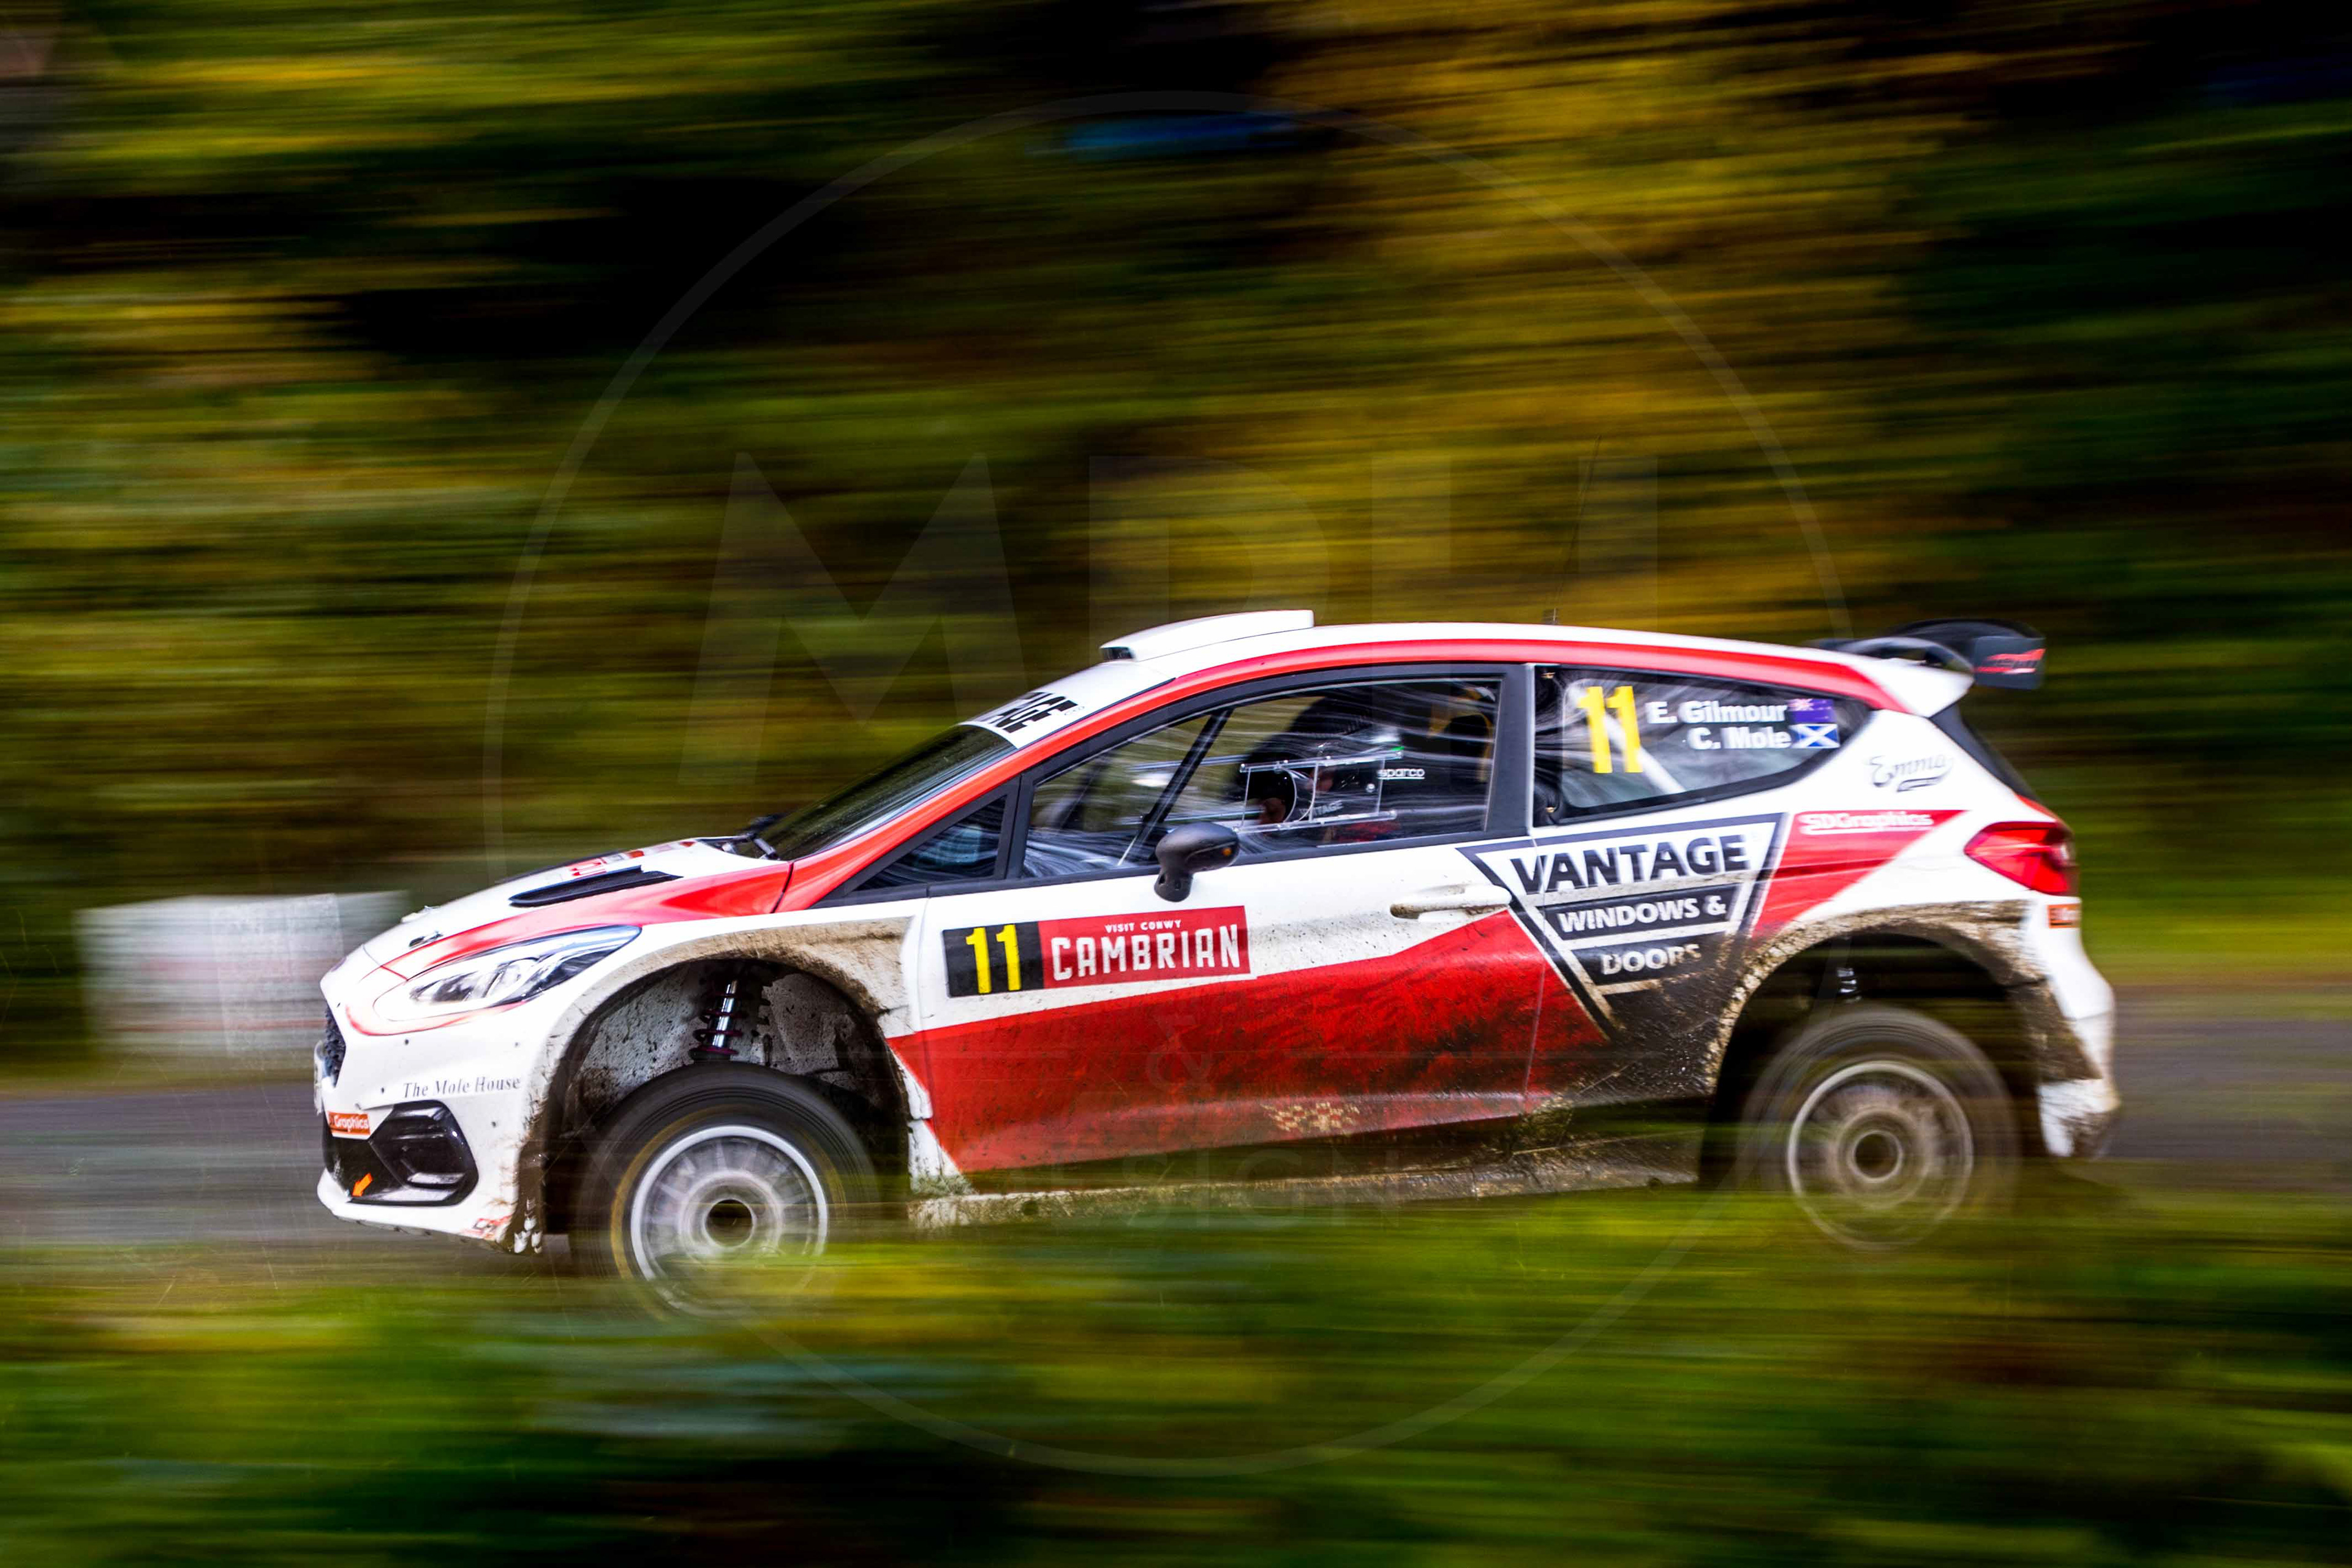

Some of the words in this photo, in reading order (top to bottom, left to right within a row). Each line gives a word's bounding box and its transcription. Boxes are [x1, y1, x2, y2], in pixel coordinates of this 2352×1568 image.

[1645, 701, 1678, 723] E.
[1678, 700, 1788, 723] Gilmour
[1577, 685, 1643, 774] 11
[1687, 727, 1721, 750] C.
[1721, 726, 1792, 749] Mole
[1377, 769, 1425, 777] sparco
[1510, 834, 1750, 895] VANTAGE
[1104, 923, 1135, 933] VISIT
[1140, 919, 1182, 930] CONWY
[1556, 898, 1700, 932] WINDOWS
[1703, 895, 1727, 915] &
[966, 924, 1020, 993] 11
[1051, 924, 1240, 981] CAMBRIAN
[404, 1082, 429, 1098] The
[474, 1076, 522, 1093] House
